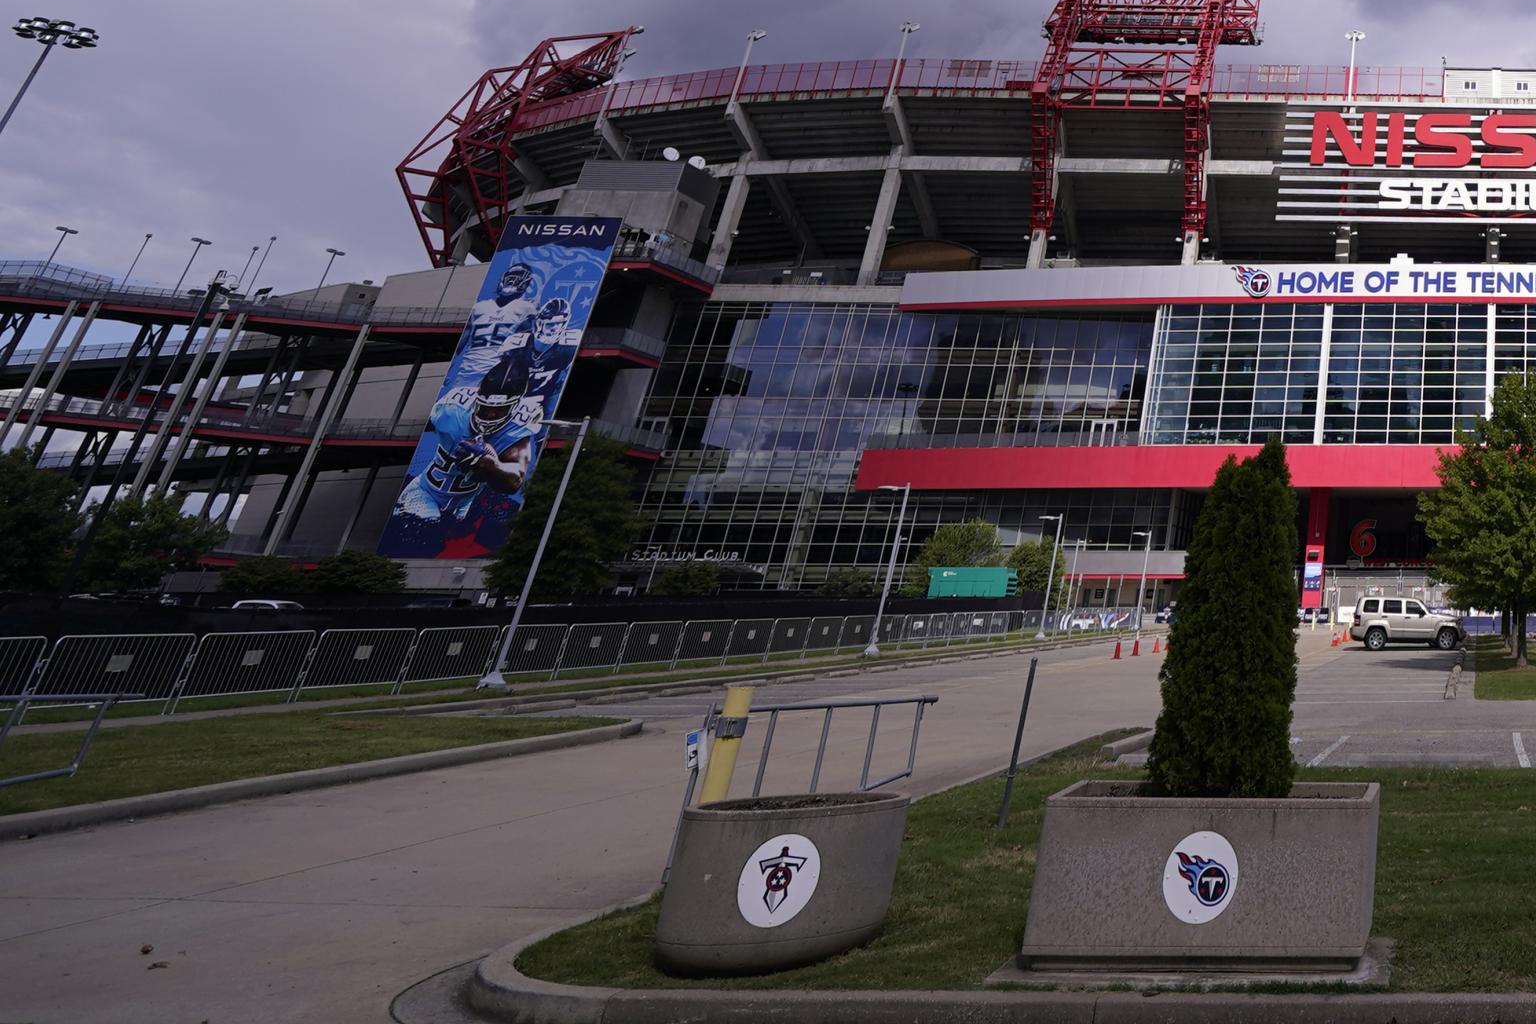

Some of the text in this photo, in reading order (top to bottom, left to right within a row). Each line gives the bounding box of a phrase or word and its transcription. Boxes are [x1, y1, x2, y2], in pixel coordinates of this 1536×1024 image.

[518, 224, 606, 236] NISSAN
[1277, 271, 1355, 294] HOME
[1364, 271, 1399, 293] OF
[1409, 271, 1457, 293] THE
[1350, 519, 1377, 557] 6
[631, 549, 739, 561] STADIUM CLUB
